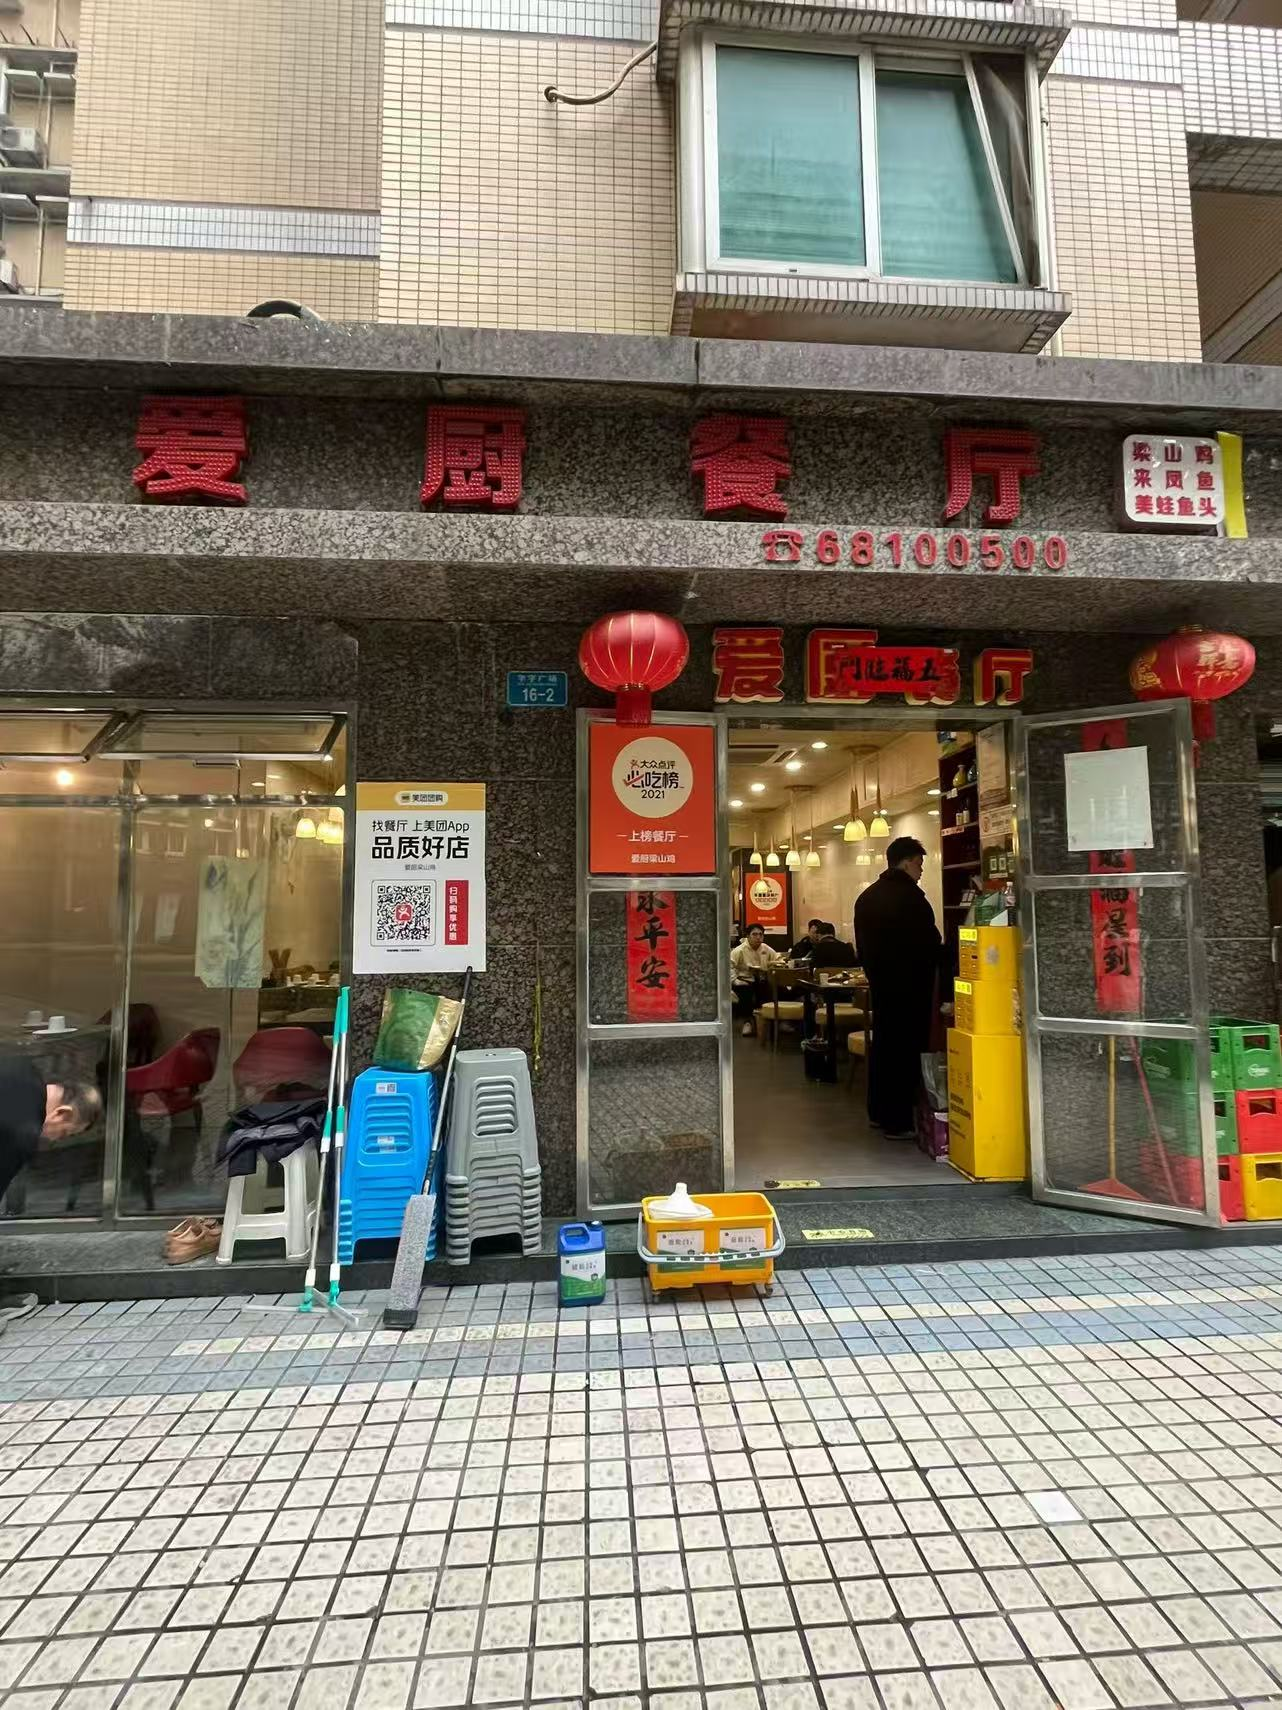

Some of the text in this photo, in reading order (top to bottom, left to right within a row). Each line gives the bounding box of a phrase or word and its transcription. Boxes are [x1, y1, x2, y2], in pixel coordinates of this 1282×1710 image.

[1133, 468, 1215, 490] 来凤鱼
[1135, 495, 1217, 517] 美蛙鱼头
[815, 528, 1067, 570] 68100500
[522, 687, 555, 702] 16-2
[640, 760, 676, 769] 大众点评
[623, 770, 680, 789] 必吃榜
[641, 789, 665, 799] 2021
[372, 820, 470, 833] 找餐厅 上美团App
[628, 830, 677, 842] 上榜餐厅
[371, 836, 470, 860] 品质好店
